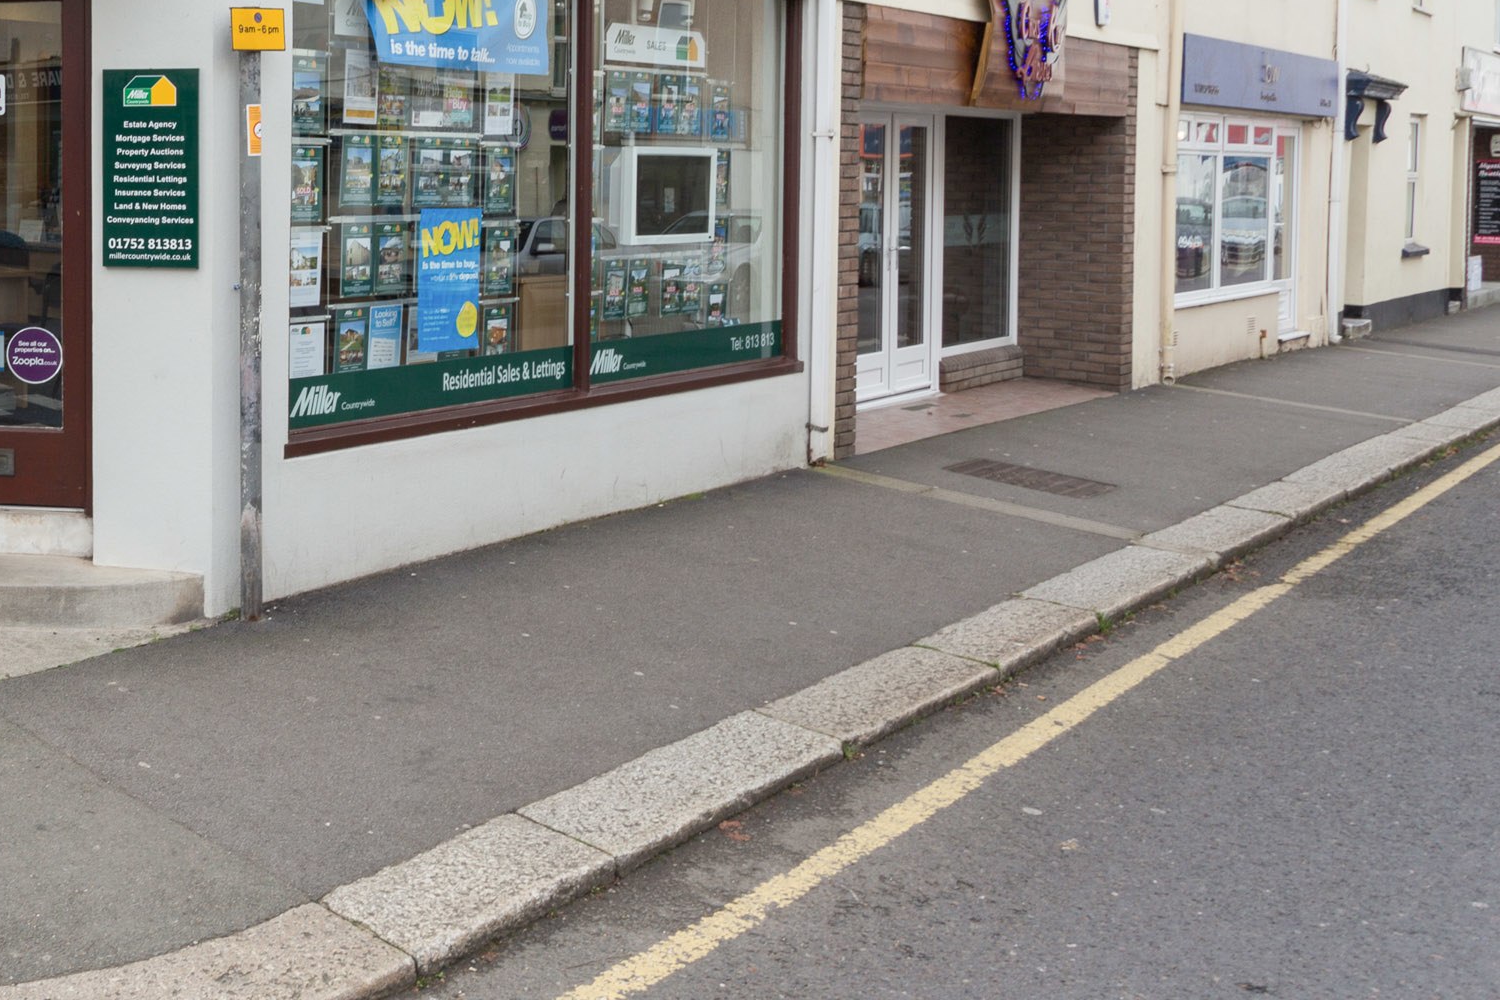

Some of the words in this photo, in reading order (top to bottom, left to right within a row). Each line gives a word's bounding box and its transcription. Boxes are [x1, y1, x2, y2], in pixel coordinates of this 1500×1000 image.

[390, 38, 403, 55] is
[405, 41, 425, 57] the
[428, 43, 455, 60] time
[457, 47, 469, 61] to
[646, 40, 666, 51] SALES
[126, 89, 149, 99] Miller
[148, 121, 177, 129] Agency
[116, 134, 151, 143] Mortgage
[152, 134, 185, 142] Services
[116, 148, 148, 157] Property
[114, 162, 152, 170] Surveying
[156, 176, 187, 184] Lettings
[296, 186, 312, 195] SOLD
[107, 216, 160, 225] Conveyancing
[161, 216, 194, 224] Services
[421, 218, 479, 258] NOW!
[108, 238, 144, 249] 01752
[148, 238, 192, 250] 813813
[109, 252, 191, 260] millercountrywide.co.uk
[442, 260, 455, 269] time
[375, 309, 397, 319] Looking
[376, 320, 381, 328] to
[731, 337, 743, 351] Tel:
[745, 335, 759, 348] 813
[761, 332, 774, 346] 813
[12, 356, 57, 368] Zoopla.co.uk
[590, 349, 624, 375] Miller
[443, 366, 495, 391] Residential
[497, 364, 520, 384] Sales
[523, 362, 530, 379] &
[532, 358, 565, 379] Lettings
[290, 384, 341, 418] Miller
[341, 398, 375, 410] Countrywide
